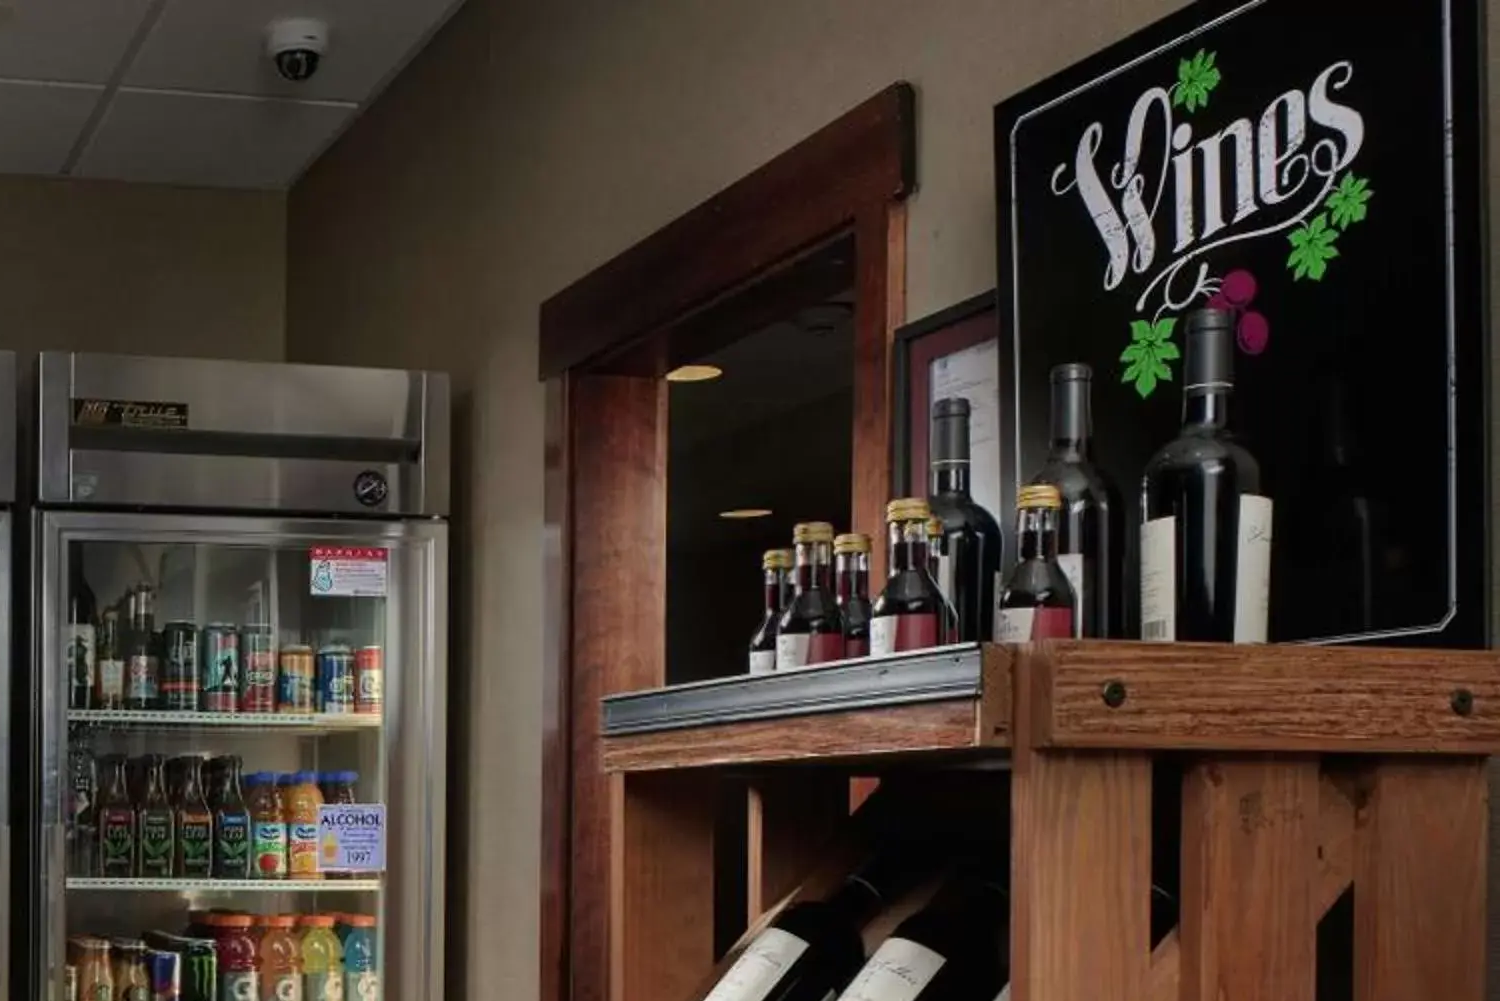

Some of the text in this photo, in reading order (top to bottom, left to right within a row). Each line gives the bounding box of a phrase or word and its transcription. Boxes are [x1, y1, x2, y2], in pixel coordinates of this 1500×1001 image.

[1051, 61, 1366, 291] Wines
[321, 813, 382, 827] ALCOHOL
[346, 851, 372, 865] 1997
